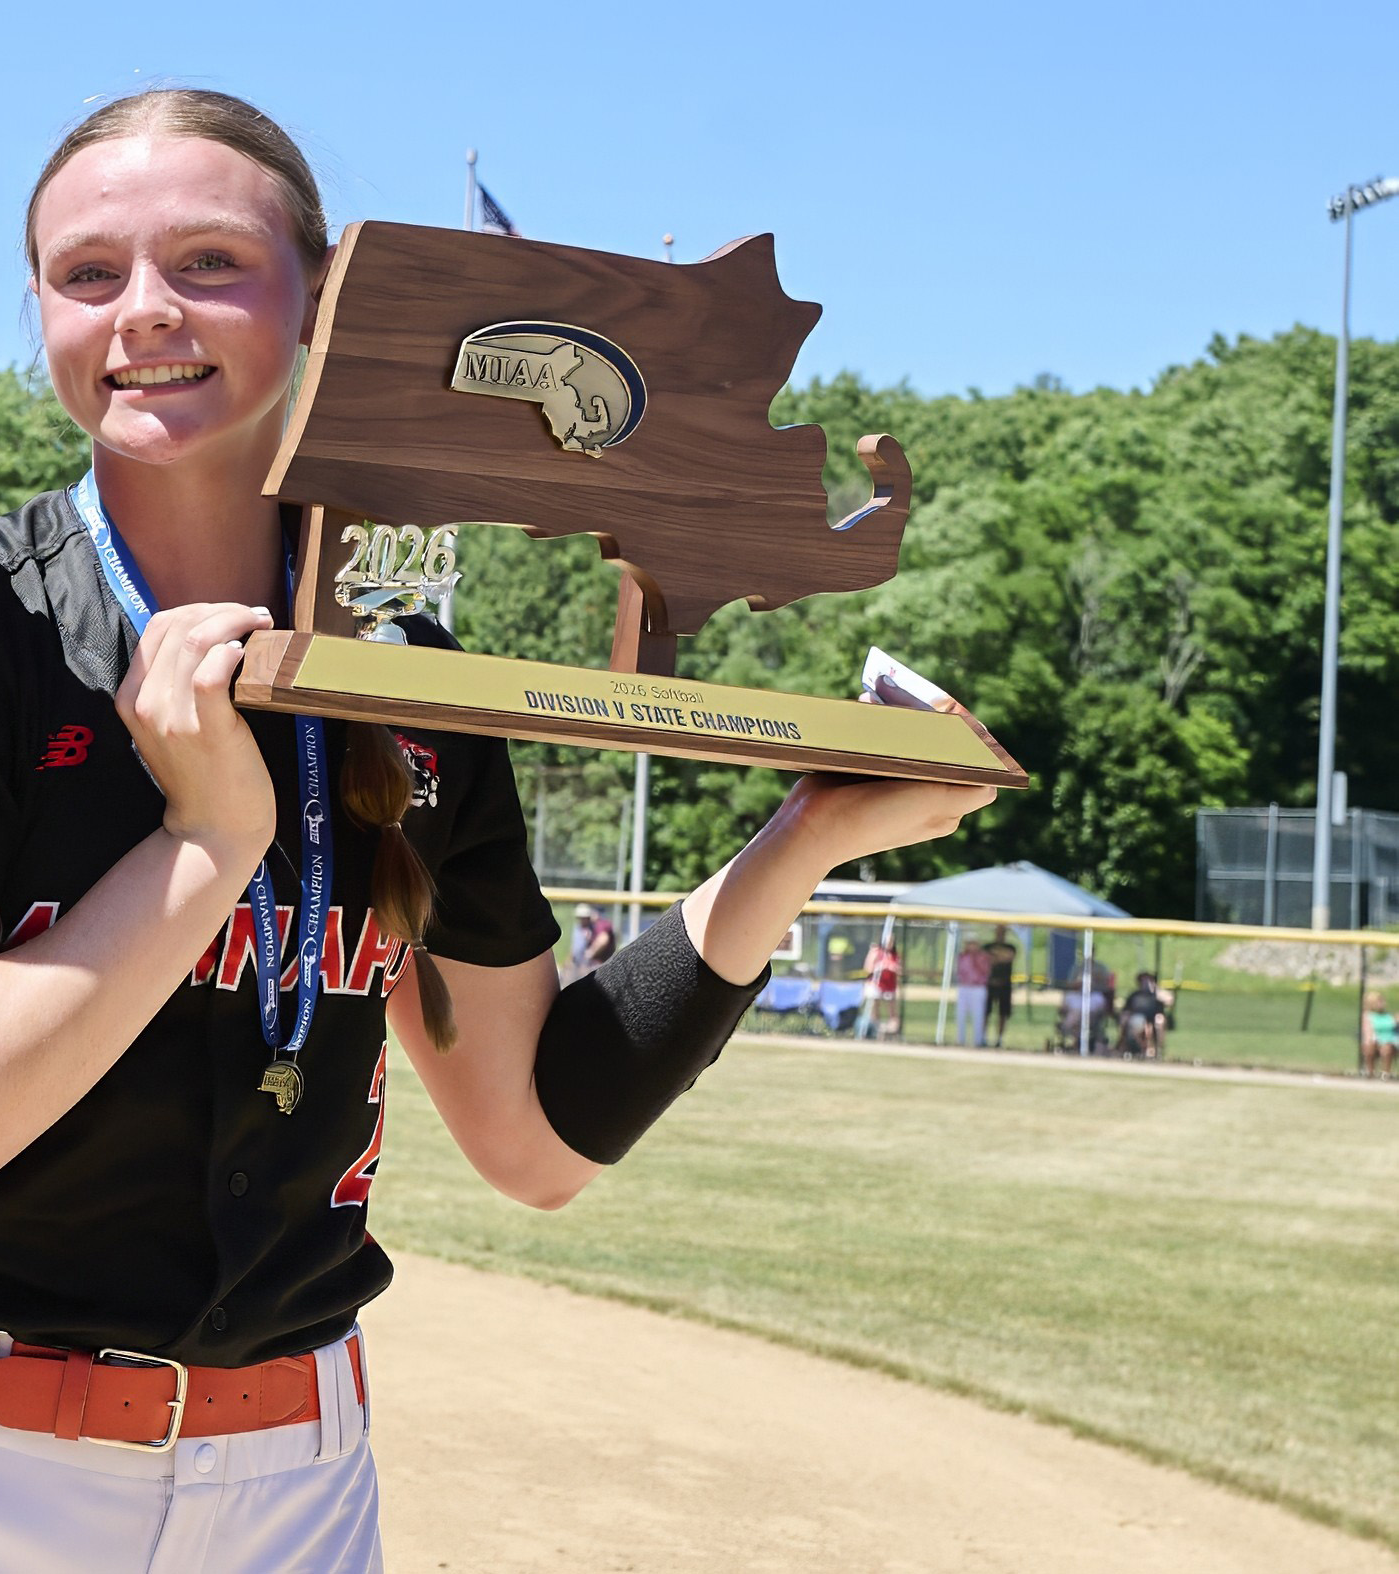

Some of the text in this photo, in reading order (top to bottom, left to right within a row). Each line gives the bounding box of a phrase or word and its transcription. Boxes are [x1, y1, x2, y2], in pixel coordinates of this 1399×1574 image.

[464, 352, 558, 391] MIAA
[104, 548, 150, 614] CHAMPION
[334, 524, 459, 584] 2026
[524, 690, 802, 740] DIVISION V STATE CHAMPIONS
[610, 681, 704, 704] 2026 Softball
[306, 724, 320, 798] CHAMPION
[256, 884, 276, 968] CHAMPION
[306, 854, 324, 936] CHAMPION
